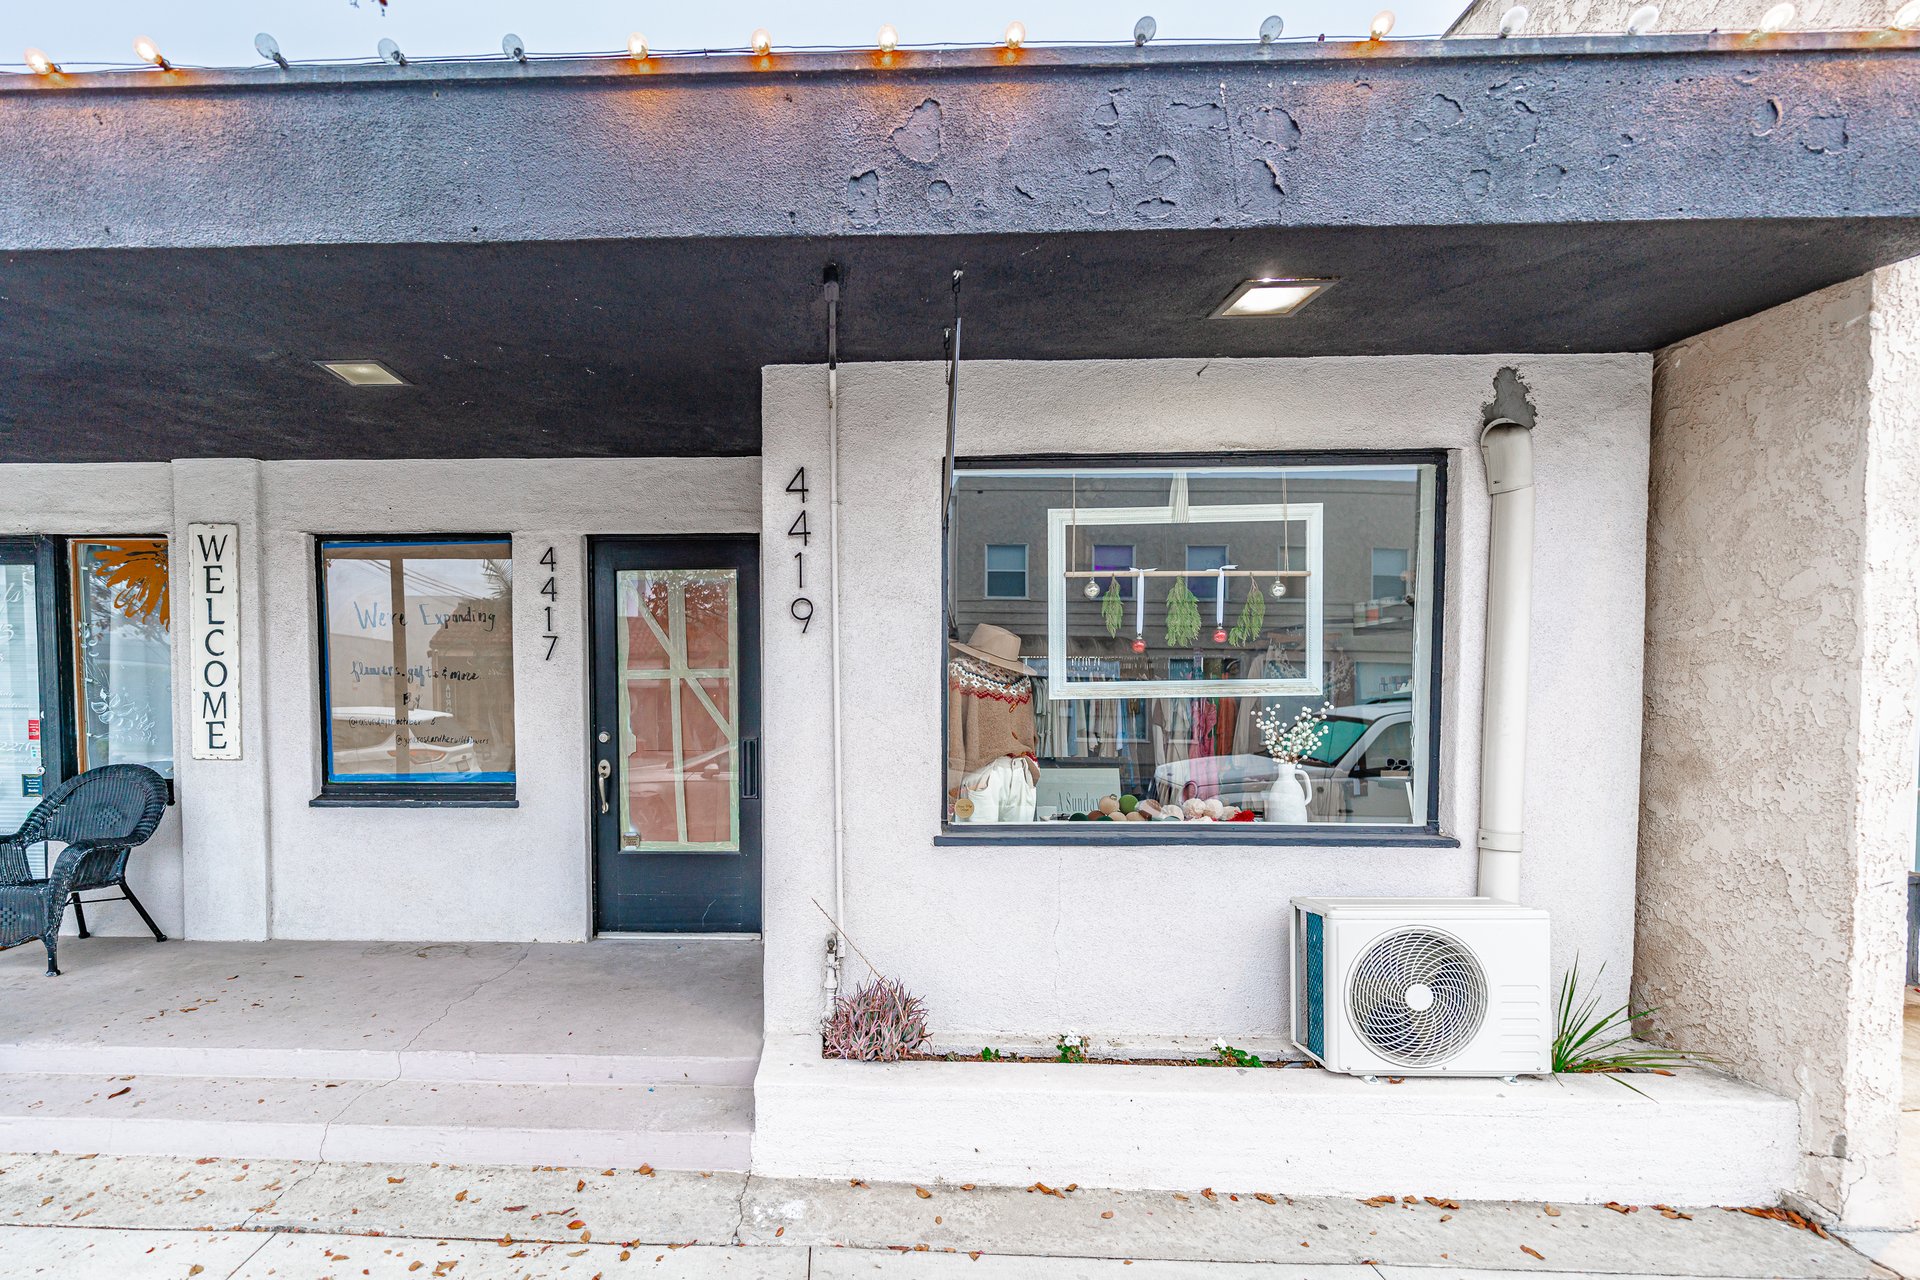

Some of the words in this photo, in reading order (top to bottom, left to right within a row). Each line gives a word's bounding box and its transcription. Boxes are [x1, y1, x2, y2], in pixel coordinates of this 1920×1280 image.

[540, 546, 559, 651] 4417
[786, 466, 813, 633] 4419
[197, 533, 228, 750] WELCOME
[419, 603, 496, 632] Expanding
[450, 671, 479, 681] more
